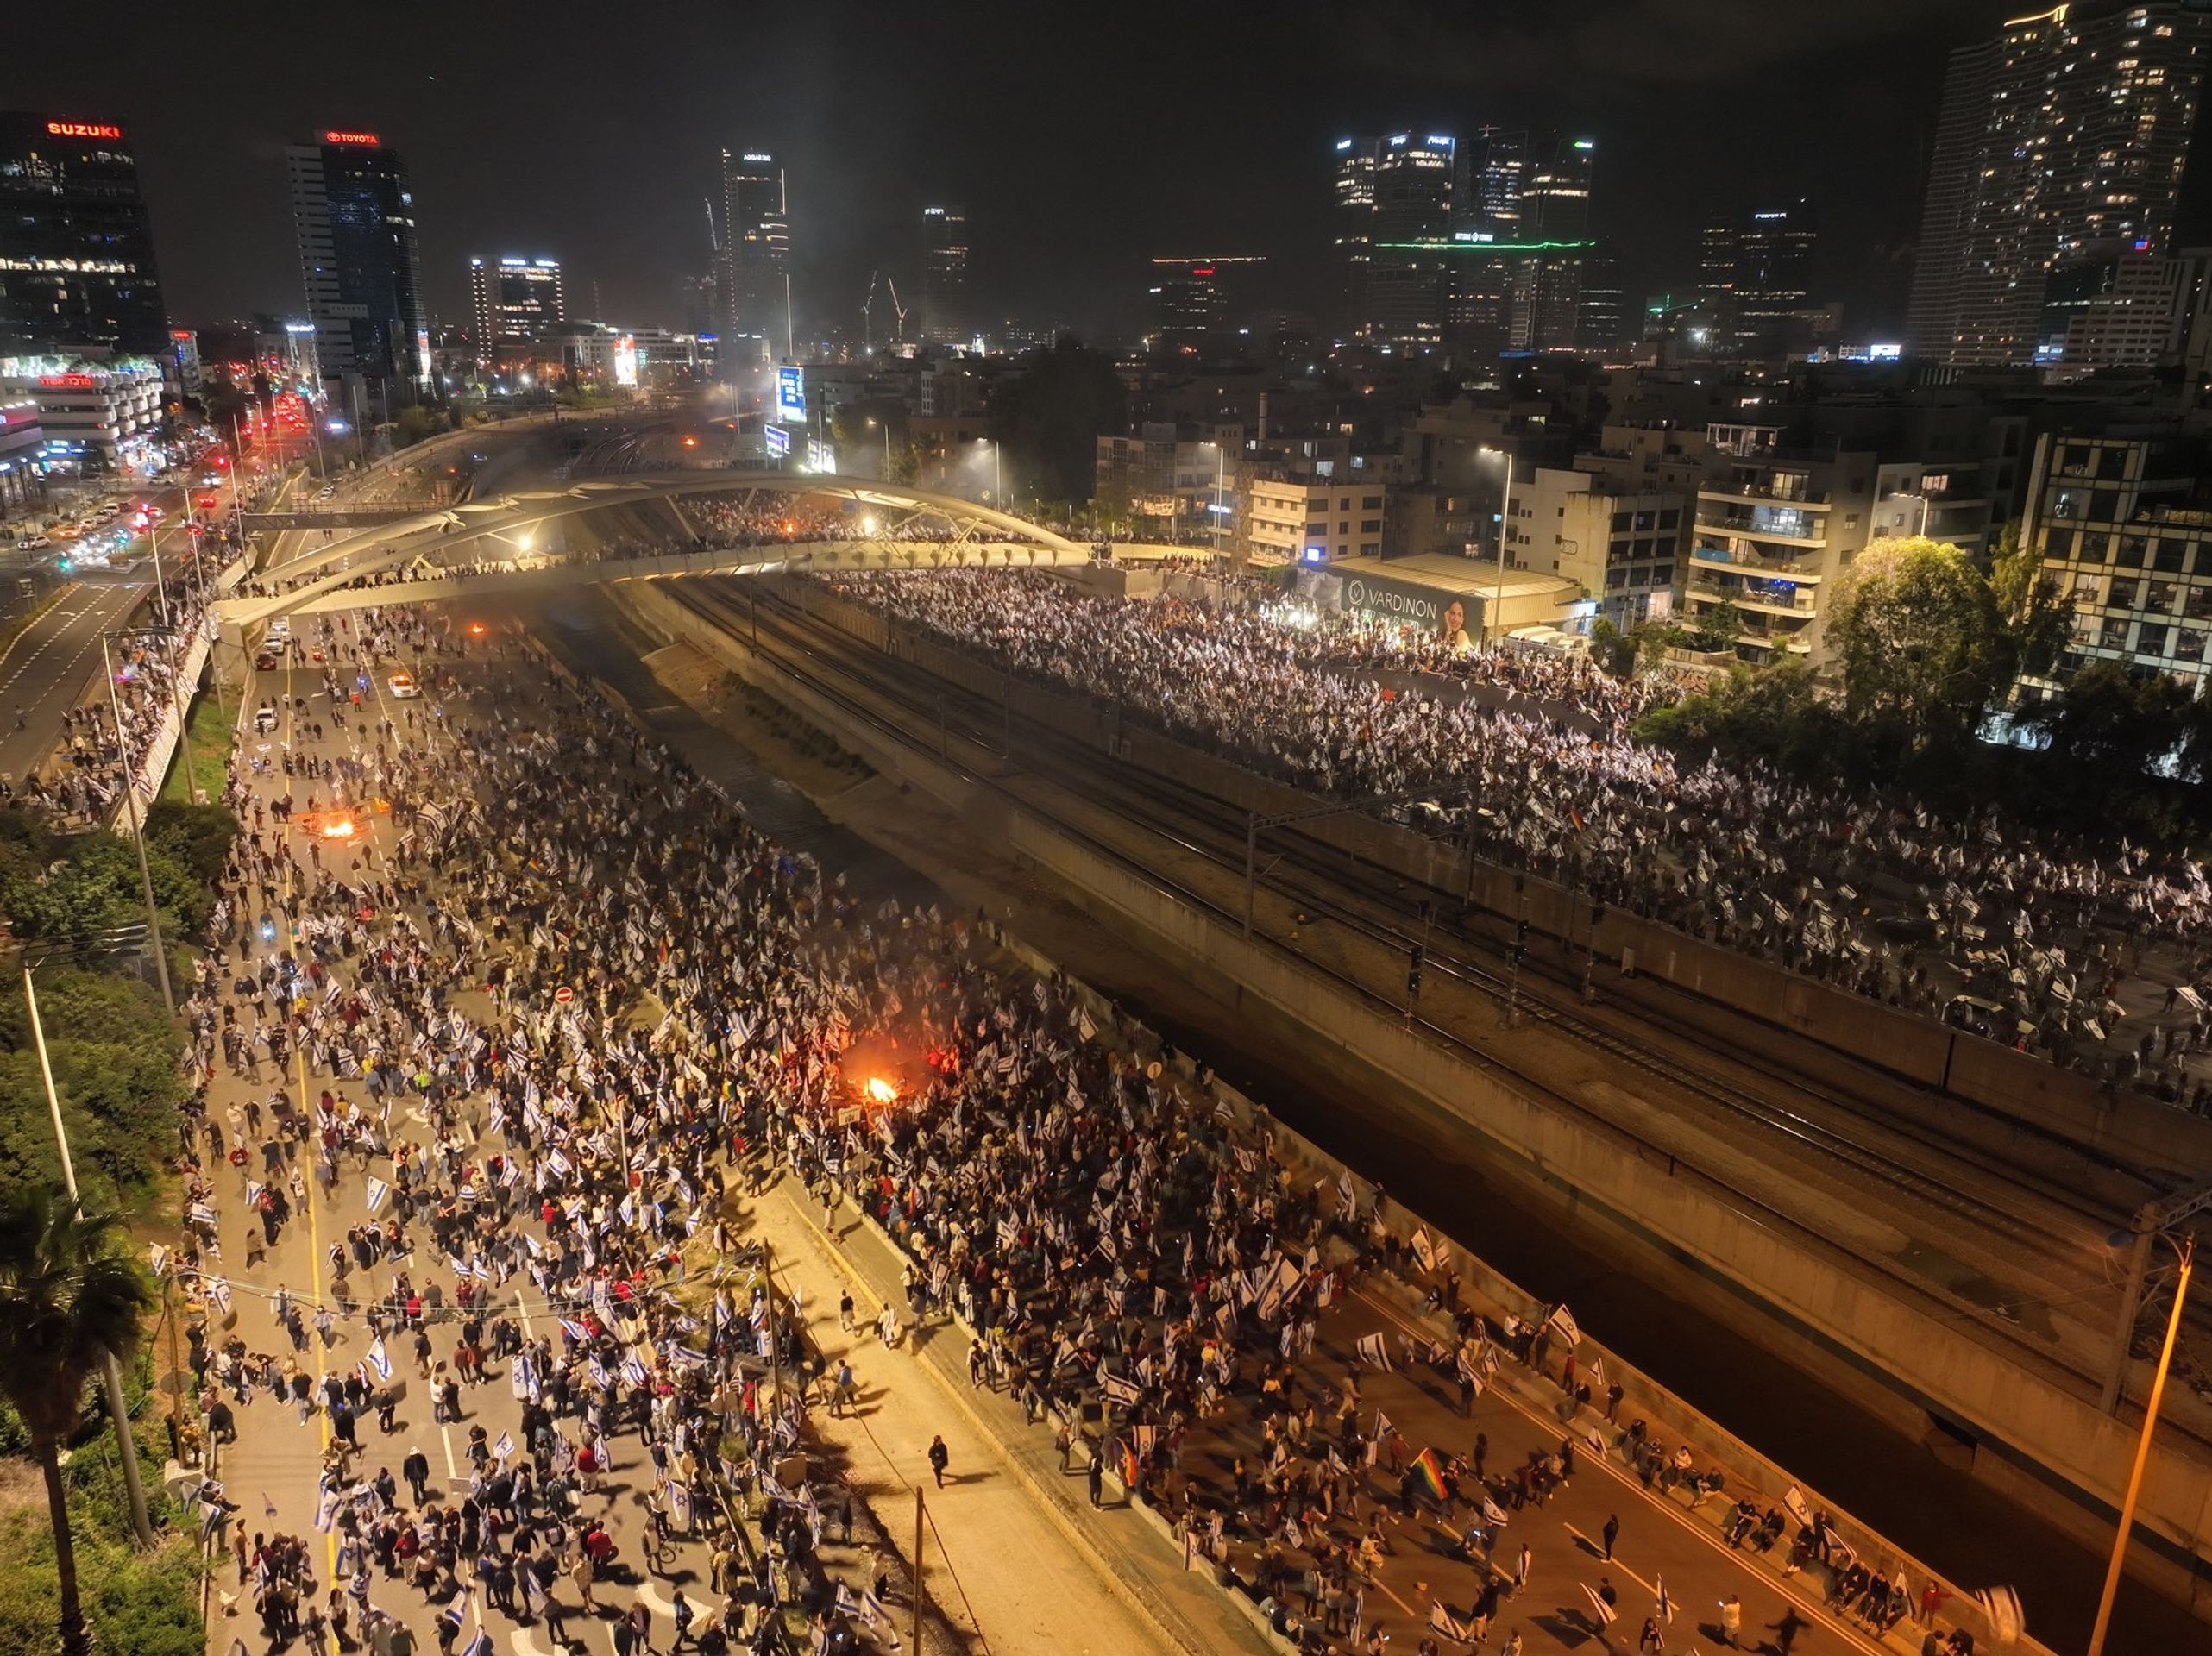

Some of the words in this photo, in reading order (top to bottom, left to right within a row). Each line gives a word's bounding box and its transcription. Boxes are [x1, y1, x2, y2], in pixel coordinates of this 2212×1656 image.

[47, 122, 120, 138] SUZUKI
[341, 134, 378, 144] TOYOTA
[1368, 587, 1437, 620] VARDINON
